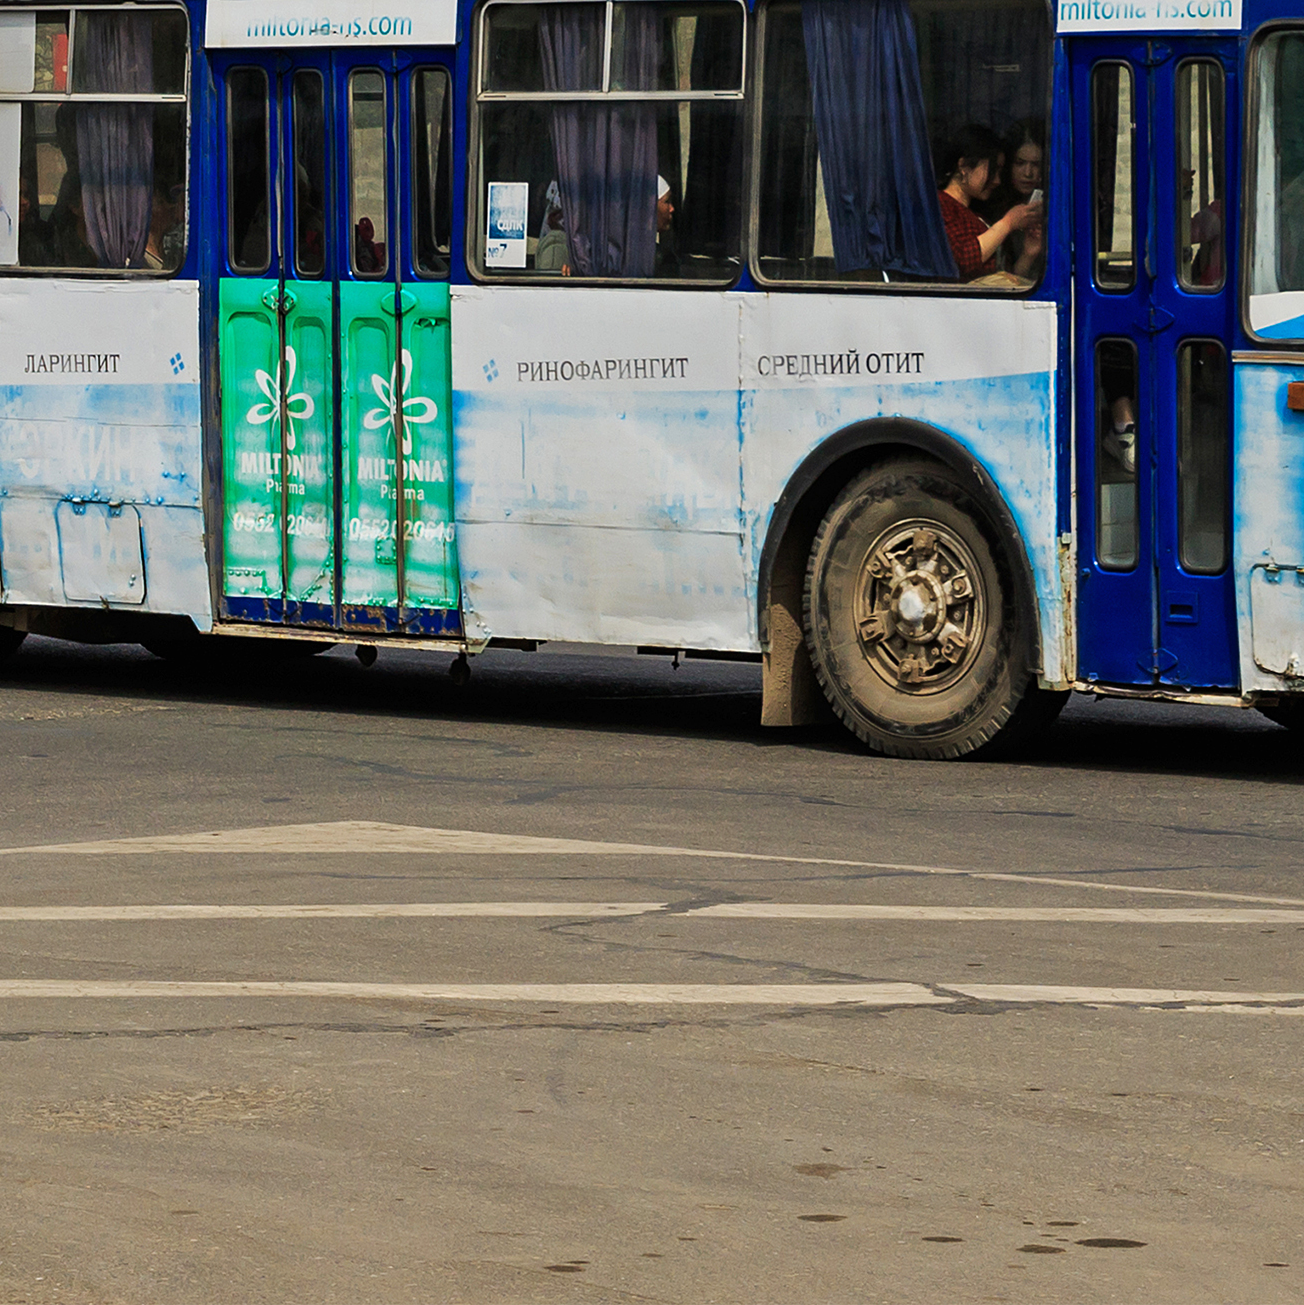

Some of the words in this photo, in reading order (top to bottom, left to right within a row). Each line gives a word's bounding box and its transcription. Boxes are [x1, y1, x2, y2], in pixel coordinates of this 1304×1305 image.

[24, 353, 121, 374] ЛАРИНГИТ
[516, 357, 689, 383] РИНОФАРИНГИТ
[757, 349, 861, 378] СРЕДНИЙ
[865, 351, 925, 375] ОТИТ
